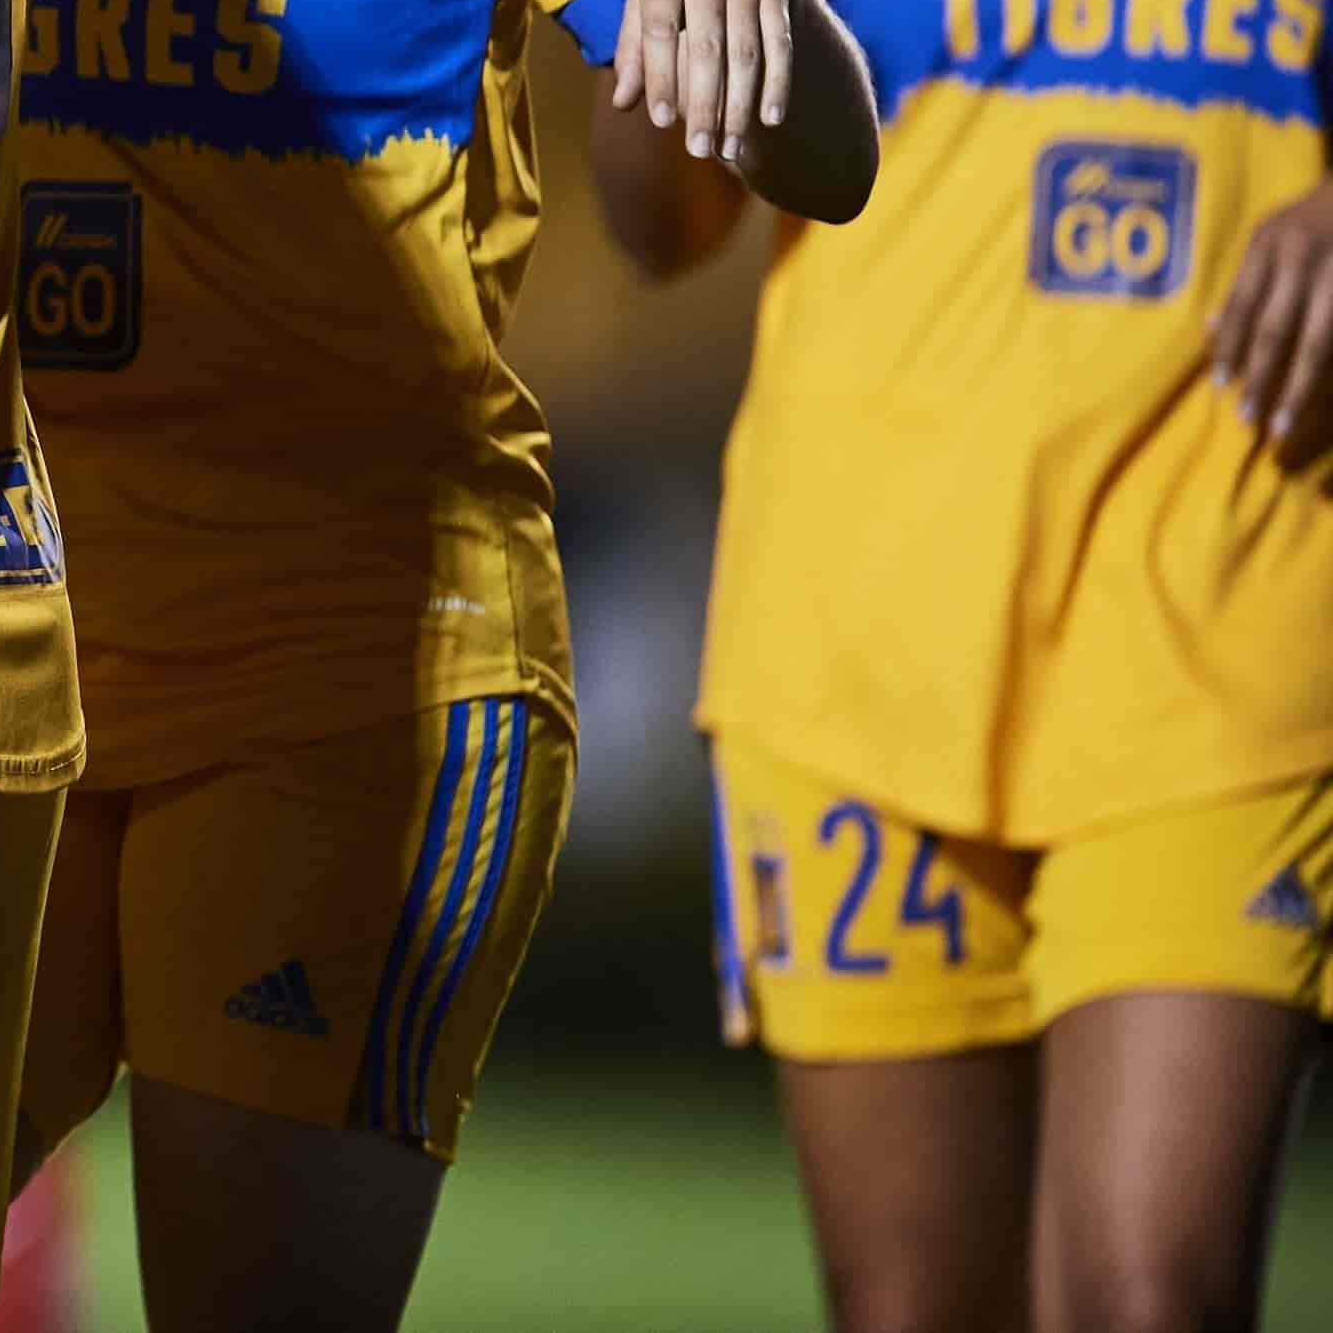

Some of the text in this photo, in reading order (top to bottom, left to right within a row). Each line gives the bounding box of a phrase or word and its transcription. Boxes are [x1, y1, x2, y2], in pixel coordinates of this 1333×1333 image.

[1053, 201, 1170, 280] GO
[26, 261, 118, 337] GO
[817, 799, 967, 974] 24
